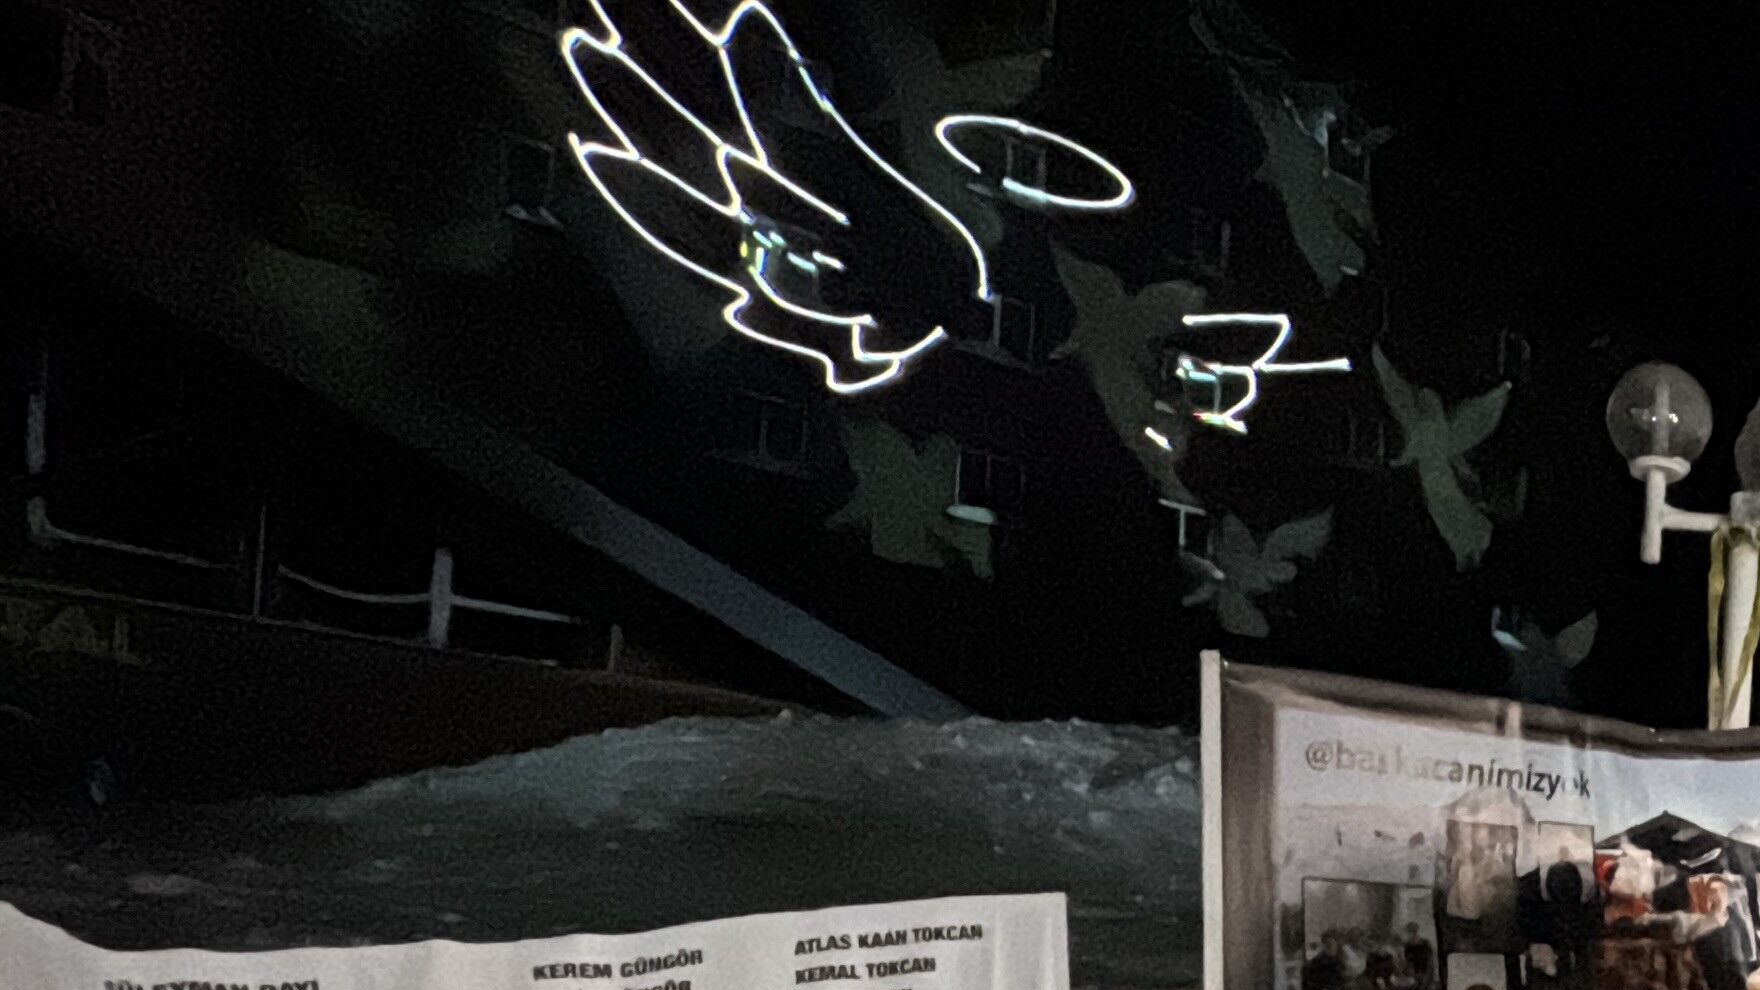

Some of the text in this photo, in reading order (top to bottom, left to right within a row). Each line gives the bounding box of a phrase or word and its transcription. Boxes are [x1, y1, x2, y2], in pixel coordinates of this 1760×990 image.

[794, 923, 984, 955] ATLAS KAAN TOKCAN
[532, 963, 613, 980] KEREM
[795, 957, 937, 985] KEMAL TOKCAN
